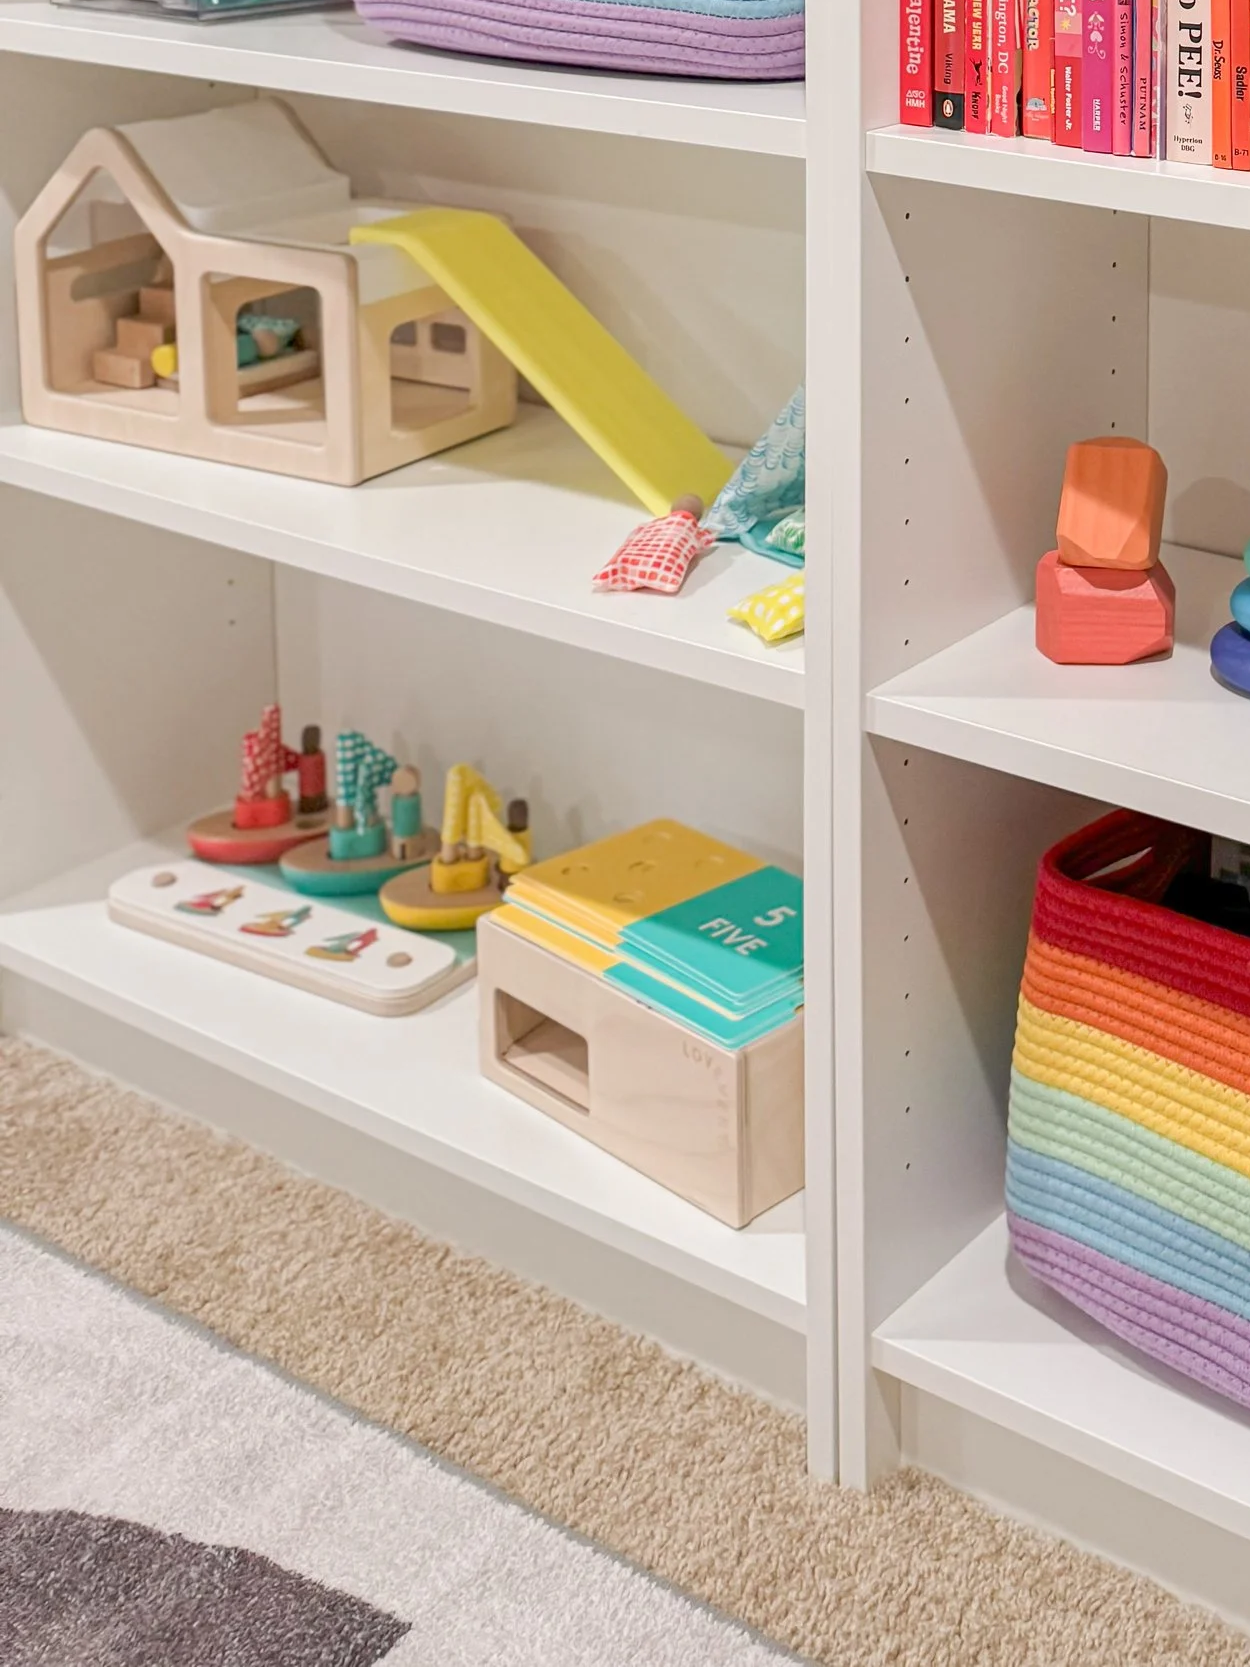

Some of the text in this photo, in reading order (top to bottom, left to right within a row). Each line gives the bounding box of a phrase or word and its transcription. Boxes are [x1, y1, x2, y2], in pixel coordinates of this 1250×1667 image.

[972, 22, 981, 50] YEAR
[944, 53, 953, 84] Viking
[998, 51, 1008, 74] DC
[1178, 21, 1202, 98] PEE!
[1139, 77, 1147, 130] PUTNAM
[751, 905, 797, 928] 5
[697, 916, 768, 956] FIVE
